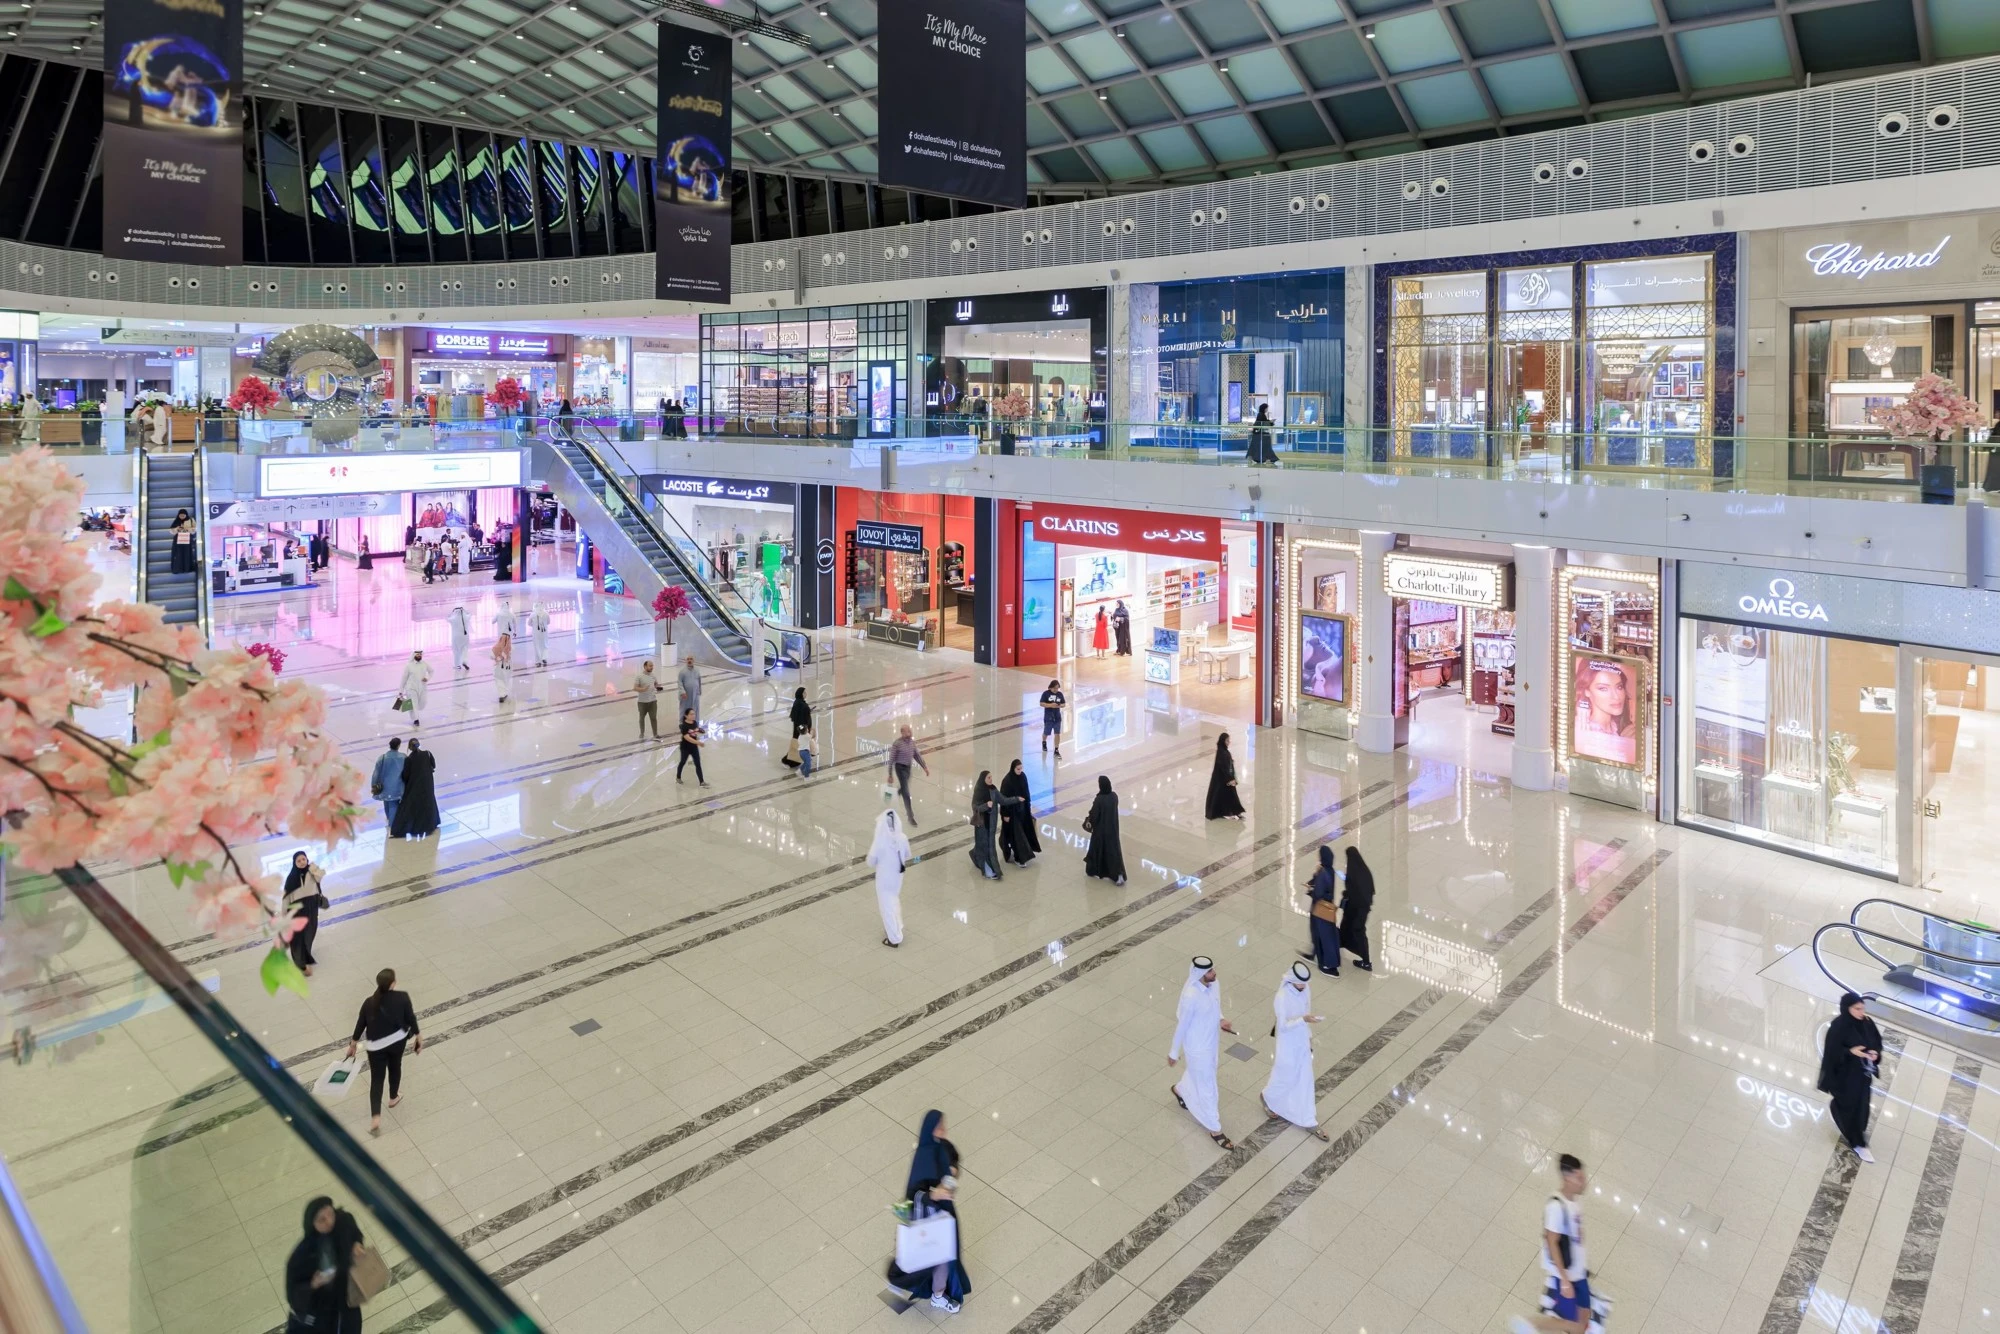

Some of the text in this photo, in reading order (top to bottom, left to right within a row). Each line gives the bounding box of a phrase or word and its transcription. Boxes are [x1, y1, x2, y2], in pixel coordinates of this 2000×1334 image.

[943, 18, 961, 42] My
[961, 24, 988, 45] Place
[932, 35, 981, 59] MY CHOICE
[913, 132, 958, 149] dohafestivalcity
[161, 161, 178, 175] My
[179, 163, 208, 175] Place
[953, 154, 1006, 171] dohafestivalcity.com
[150, 171, 201, 184] MY CHOICE
[1805, 235, 1951, 280] Chopard
[1590, 277, 1641, 292] الفردان
[1394, 287, 1483, 301] Alfardan Jewellery
[1141, 312, 1187, 323] MARLI
[1276, 303, 1328, 320] مارلي
[436, 334, 489, 346] BORDERS
[662, 479, 703, 493] LACOSTE
[727, 486, 769, 499] لاكوست
[210, 504, 220, 514] G
[1041, 516, 1120, 536] CLARINS
[860, 528, 885, 541] JOVOY
[1143, 528, 1206, 543] كلارنس
[820, 552, 833, 560] JOVOY
[1739, 595, 1830, 622] OMEGA
[1776, 725, 1813, 740] OMEGA
